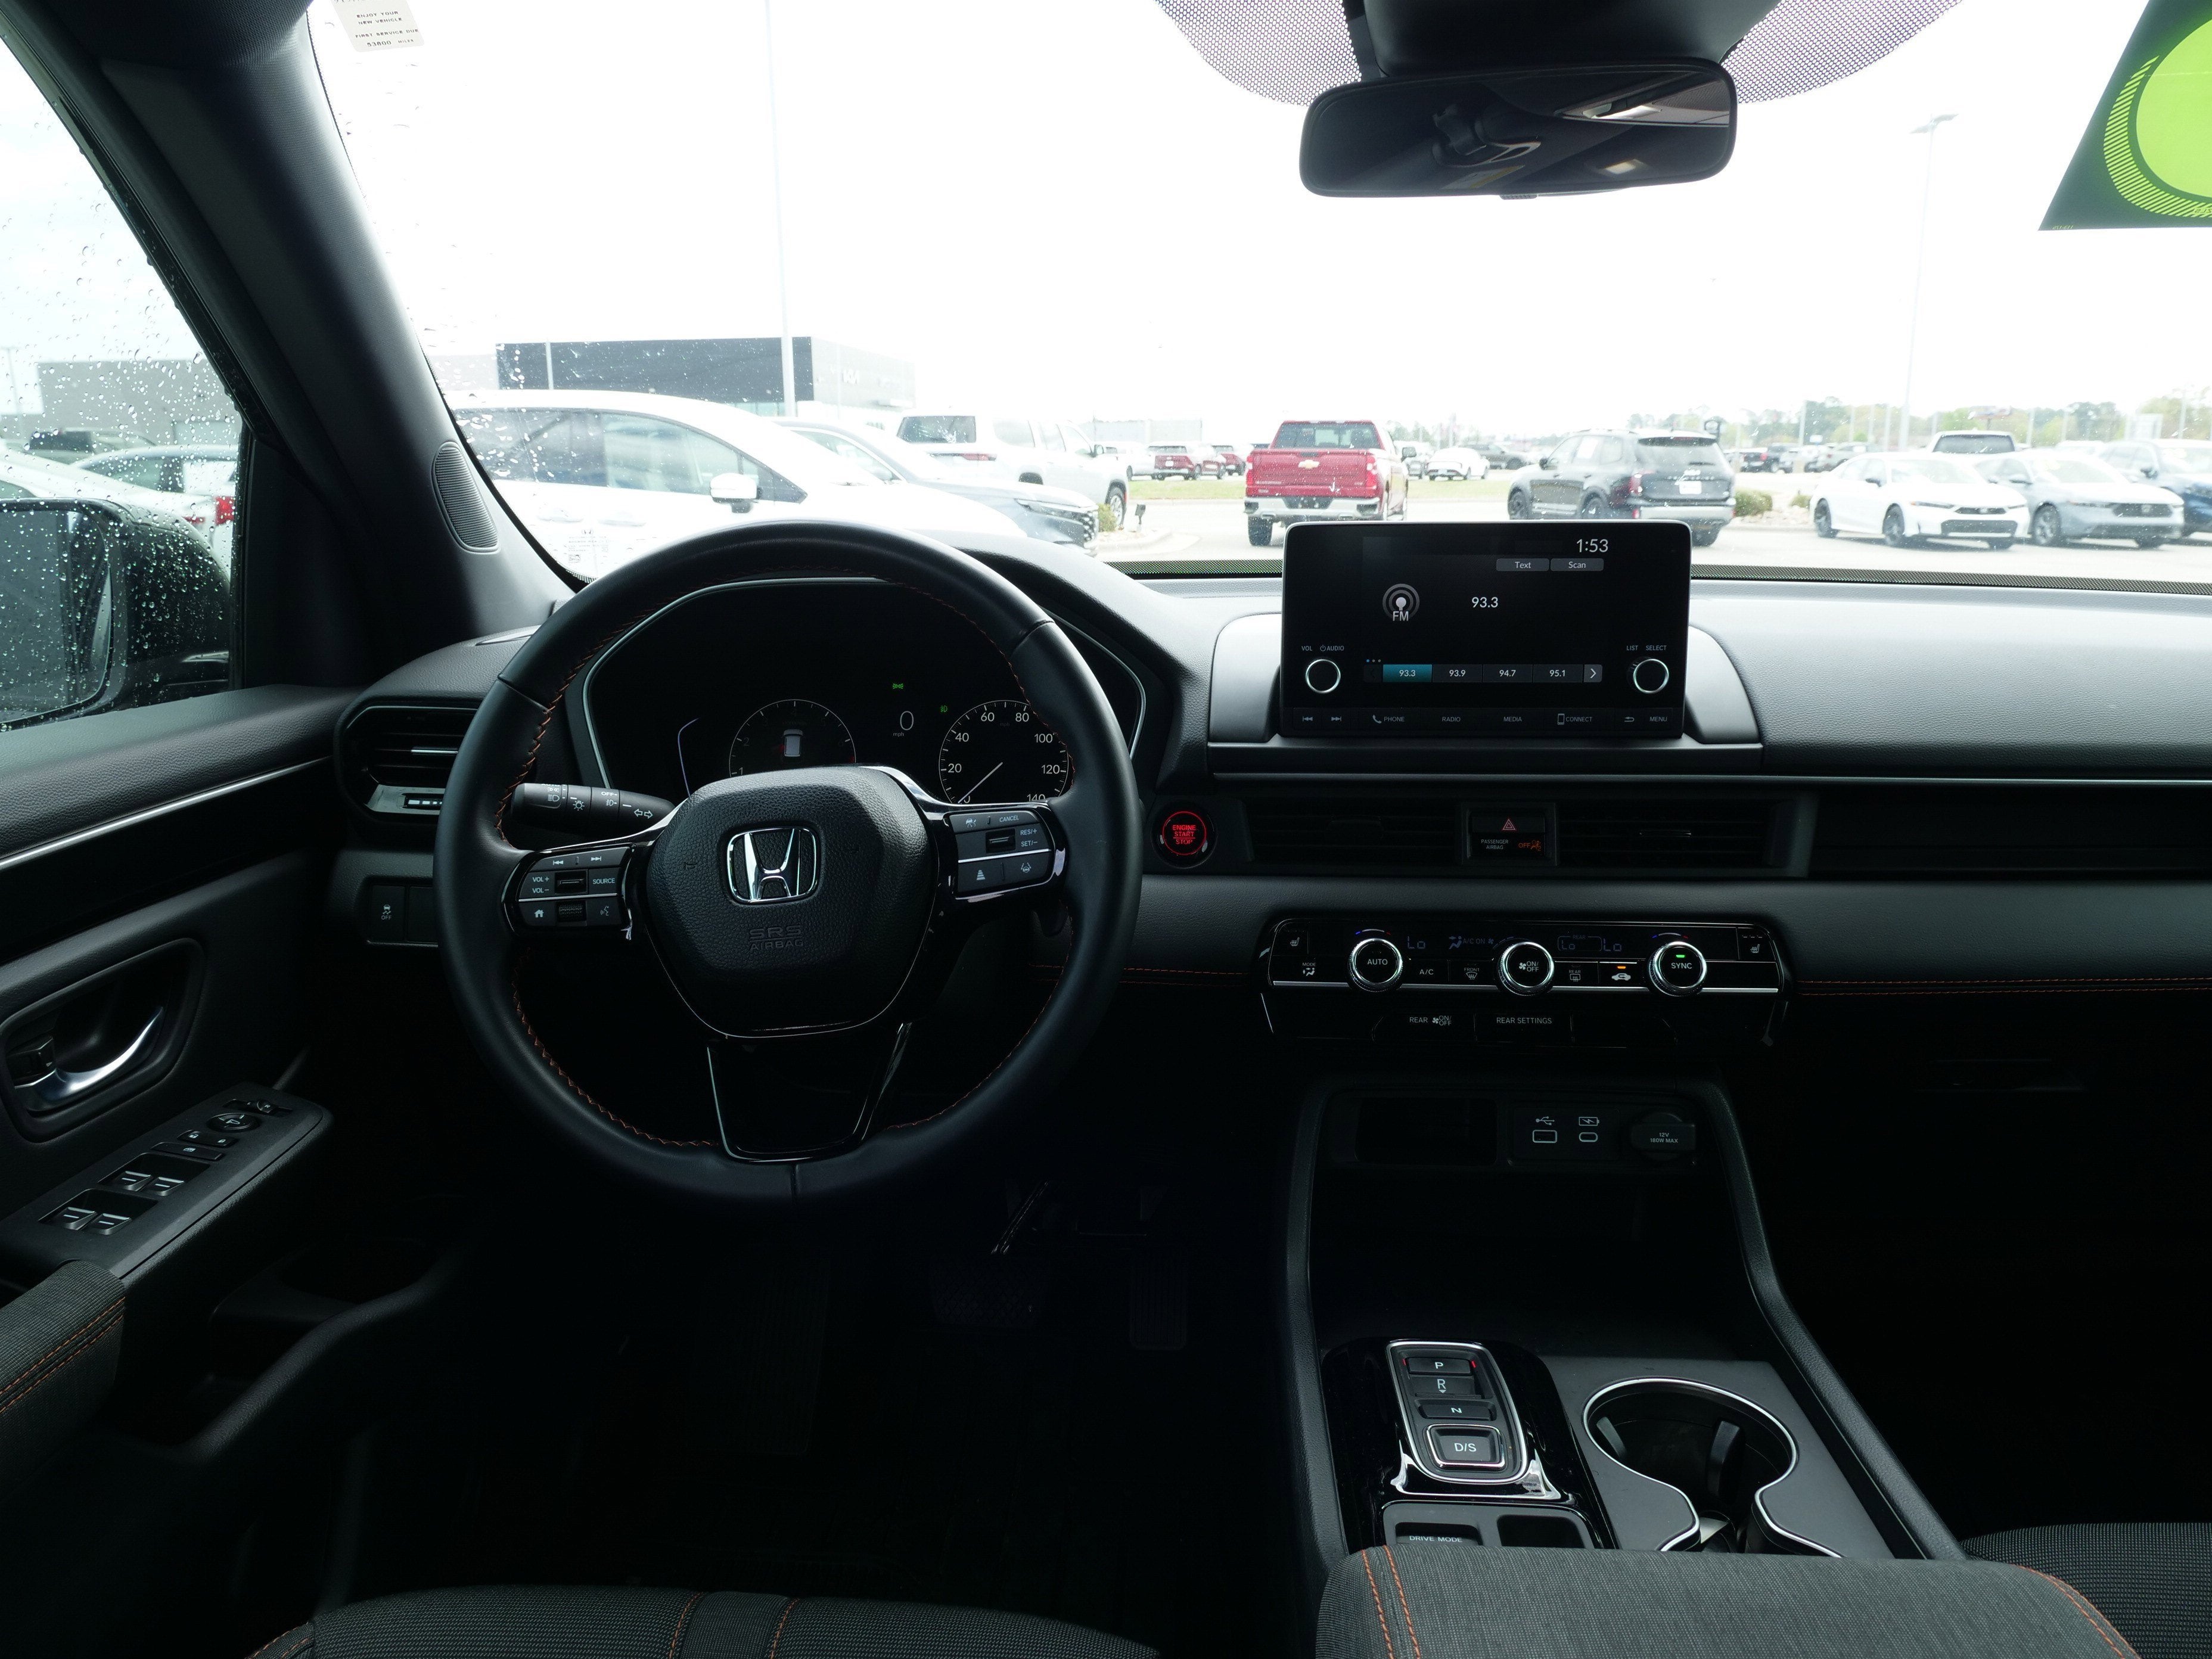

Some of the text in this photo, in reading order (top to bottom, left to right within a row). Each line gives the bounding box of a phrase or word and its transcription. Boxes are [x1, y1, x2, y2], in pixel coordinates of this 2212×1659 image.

[1577, 539, 1608, 553] 1:53
[1515, 561, 1531, 570] Text
[1568, 561, 1586, 570] Scan
[1471, 597, 1499, 608] 93.3
[1393, 611, 1409, 622] FM
[1399, 669, 1416, 678] 93.3
[1449, 669, 1466, 678] 93.9
[1499, 669, 1517, 678] 94.7
[1549, 669, 1566, 678] 95.1
[900, 711, 914, 731] 0
[980, 713, 995, 722] 60
[1015, 713, 1029, 722] 80
[743, 737, 750, 746] 2
[955, 732, 970, 742] 40
[1034, 734, 1053, 743] 100
[947, 763, 962, 773] 20
[1041, 765, 1061, 774] 120
[1026, 794, 1046, 802] 140
[749, 925, 802, 938] SRS
[750, 940, 804, 951] AIRBAG
[1437, 1378, 1446, 1390] R
[1454, 1443, 1477, 1452] D/S
